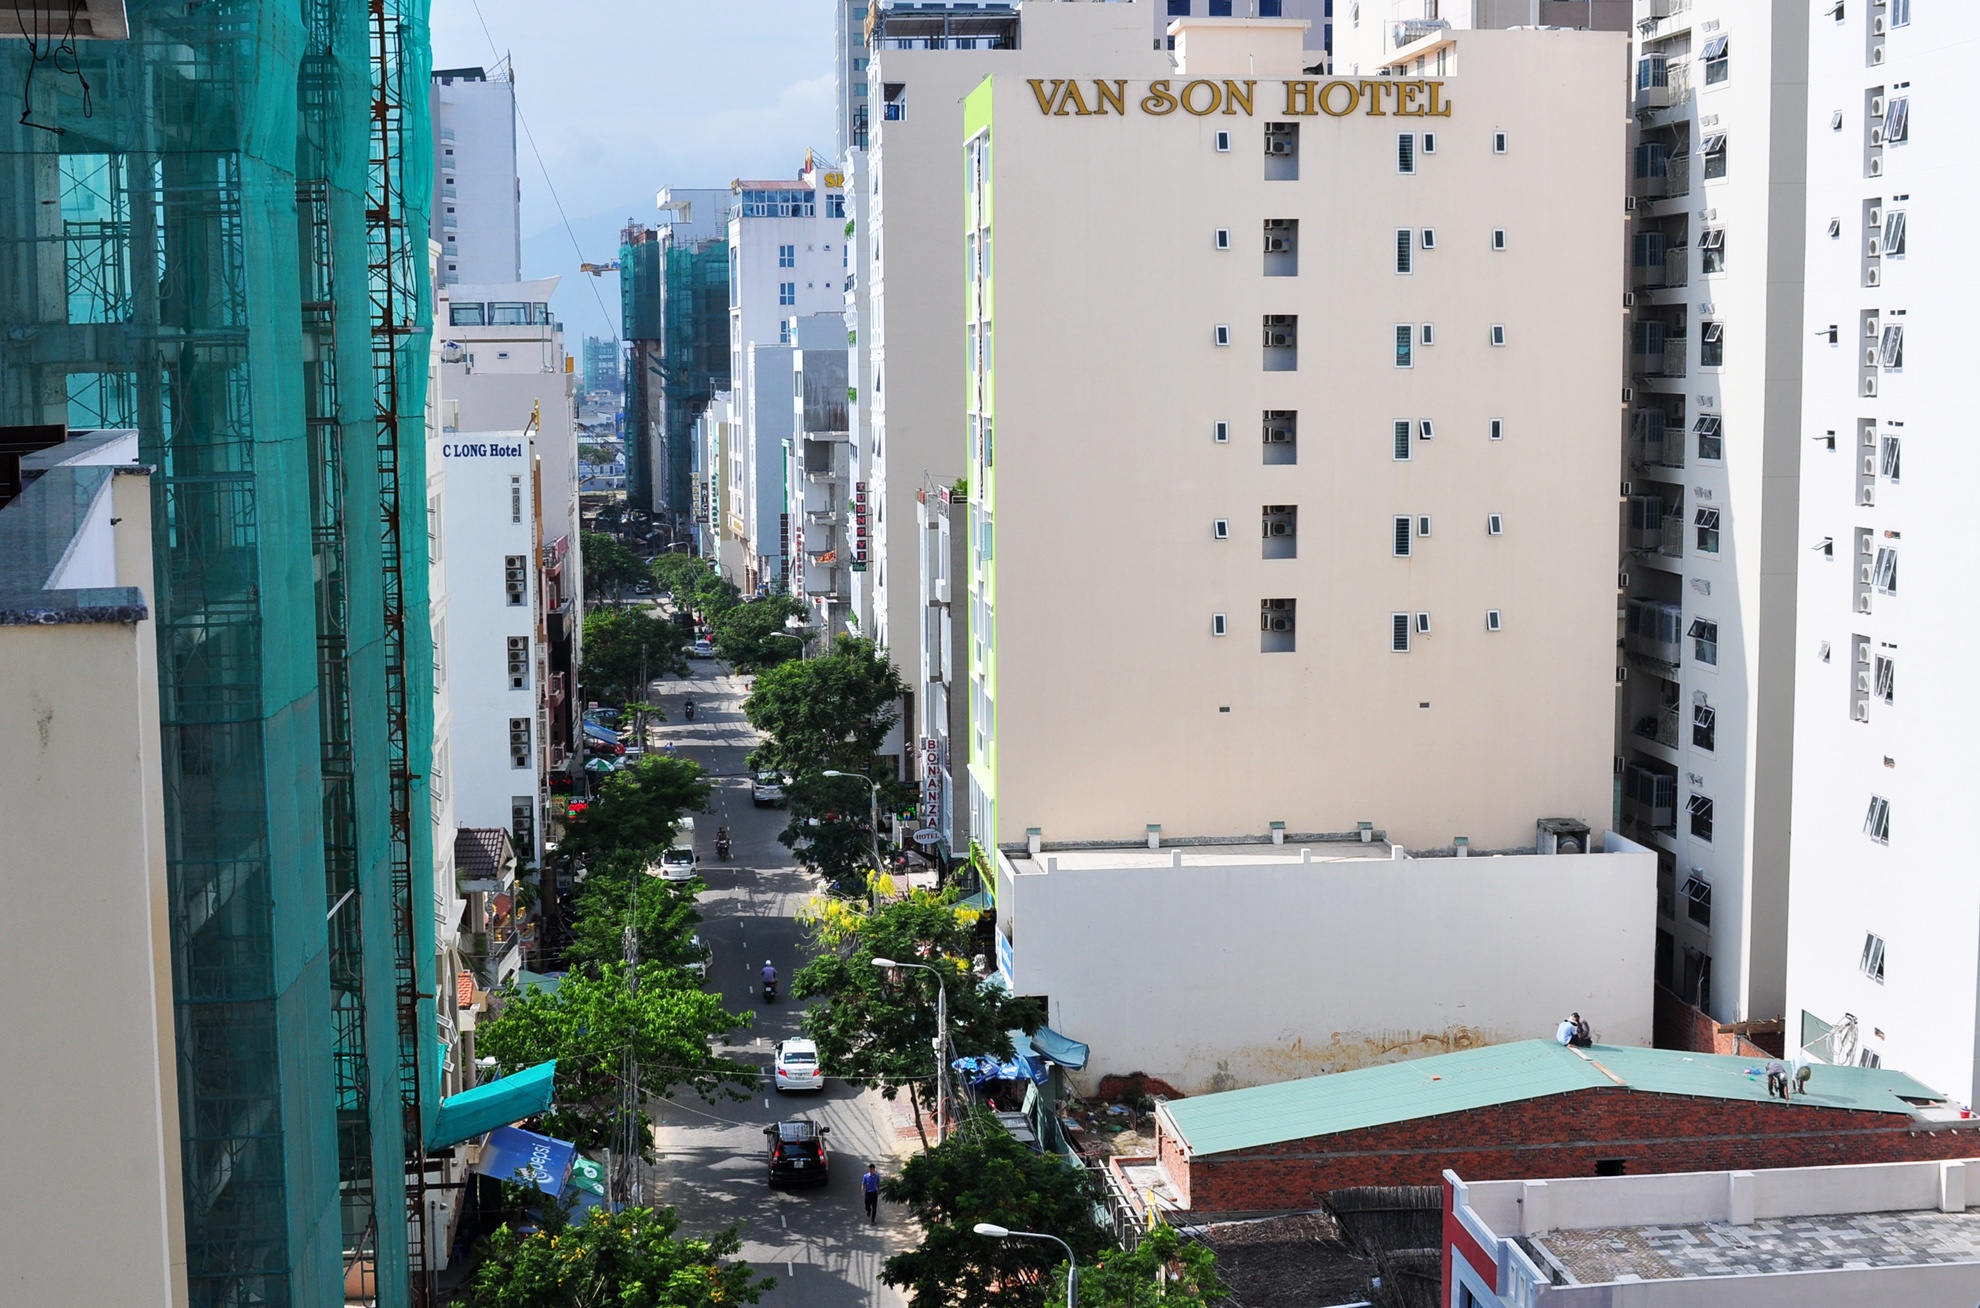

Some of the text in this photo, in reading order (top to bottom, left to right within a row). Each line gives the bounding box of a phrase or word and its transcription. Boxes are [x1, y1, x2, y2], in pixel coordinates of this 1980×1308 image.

[1026, 78, 1452, 117] VAN SON HOTEL
[453, 443, 488, 458] LONG
[489, 443, 522, 457] Hotel
[927, 740, 937, 827] BONANZA
[916, 832, 939, 840] HOTEL
[530, 1143, 551, 1172] pepsi
